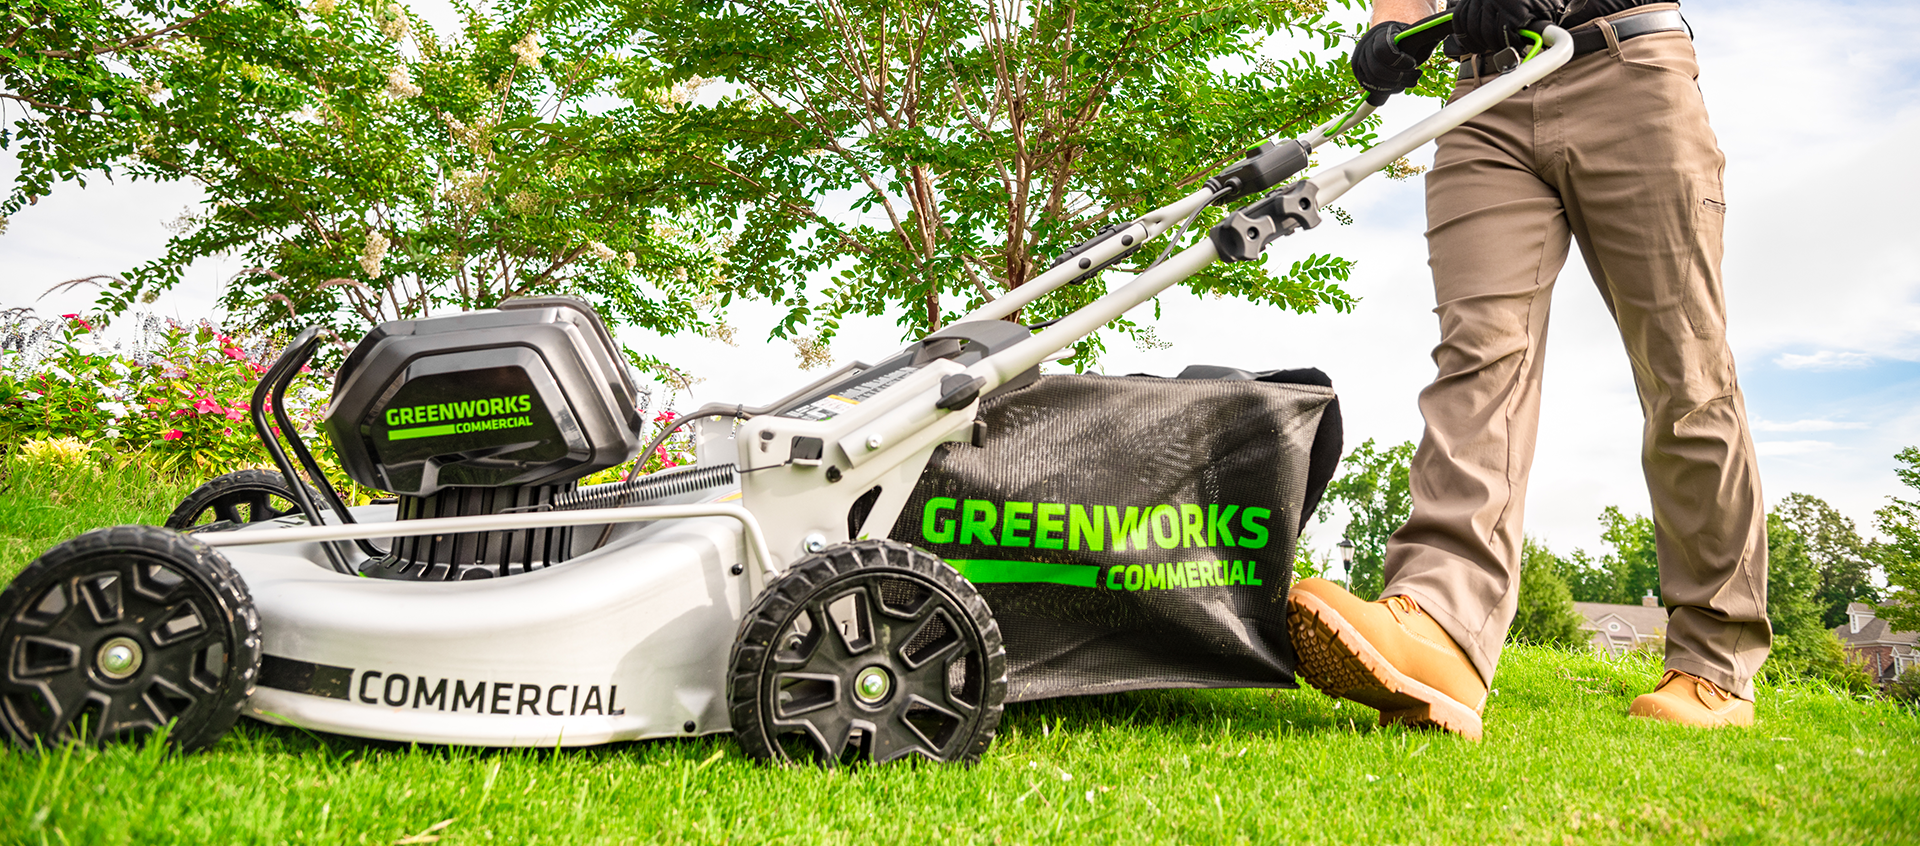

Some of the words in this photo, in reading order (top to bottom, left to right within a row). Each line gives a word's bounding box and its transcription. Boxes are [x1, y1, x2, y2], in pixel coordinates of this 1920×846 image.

[386, 394, 532, 427] GREENWORKS
[455, 415, 533, 434] COMMERCIAL
[922, 496, 1271, 552] GREENWORKS
[1106, 560, 1263, 591] COMMERCIAL
[358, 670, 626, 717] COMMERCIAL
